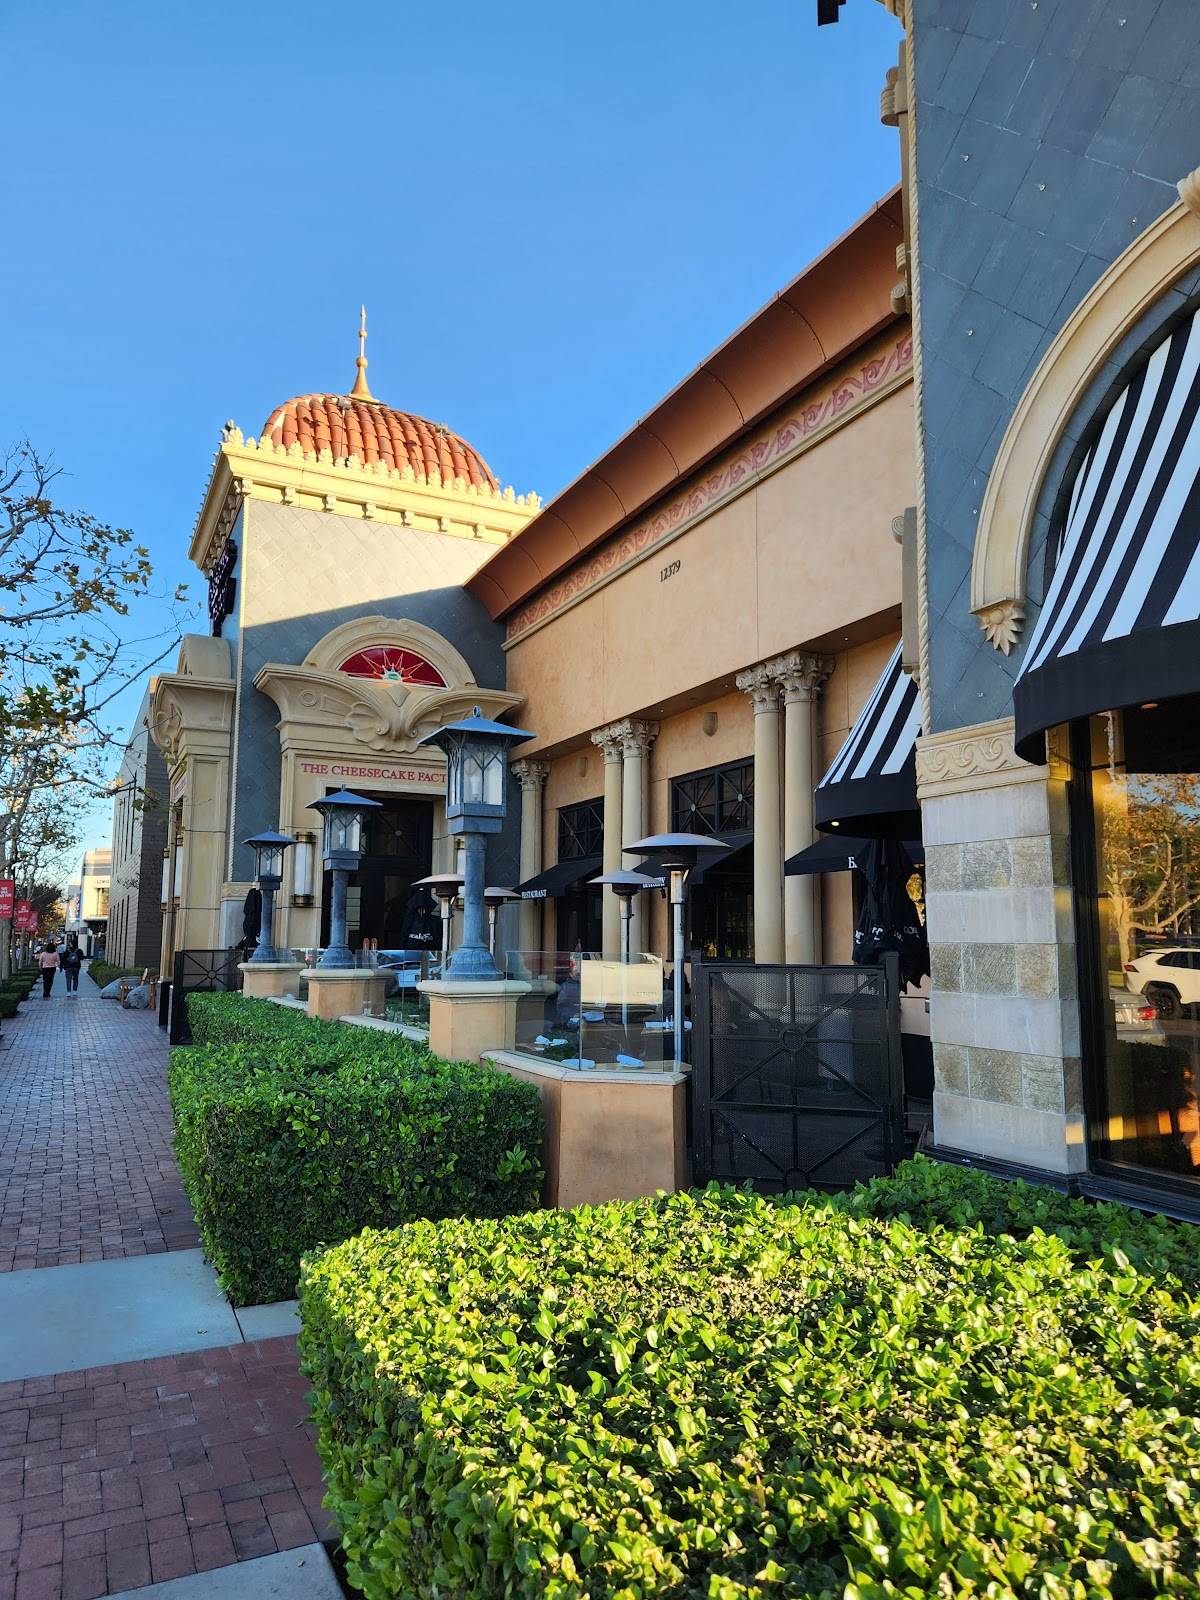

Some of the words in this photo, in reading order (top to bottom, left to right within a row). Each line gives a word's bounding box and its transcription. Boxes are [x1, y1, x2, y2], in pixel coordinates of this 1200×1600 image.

[660, 560, 680, 582] 12379
[301, 763, 328, 774] THE
[331, 765, 415, 781] CHEESECAKE
